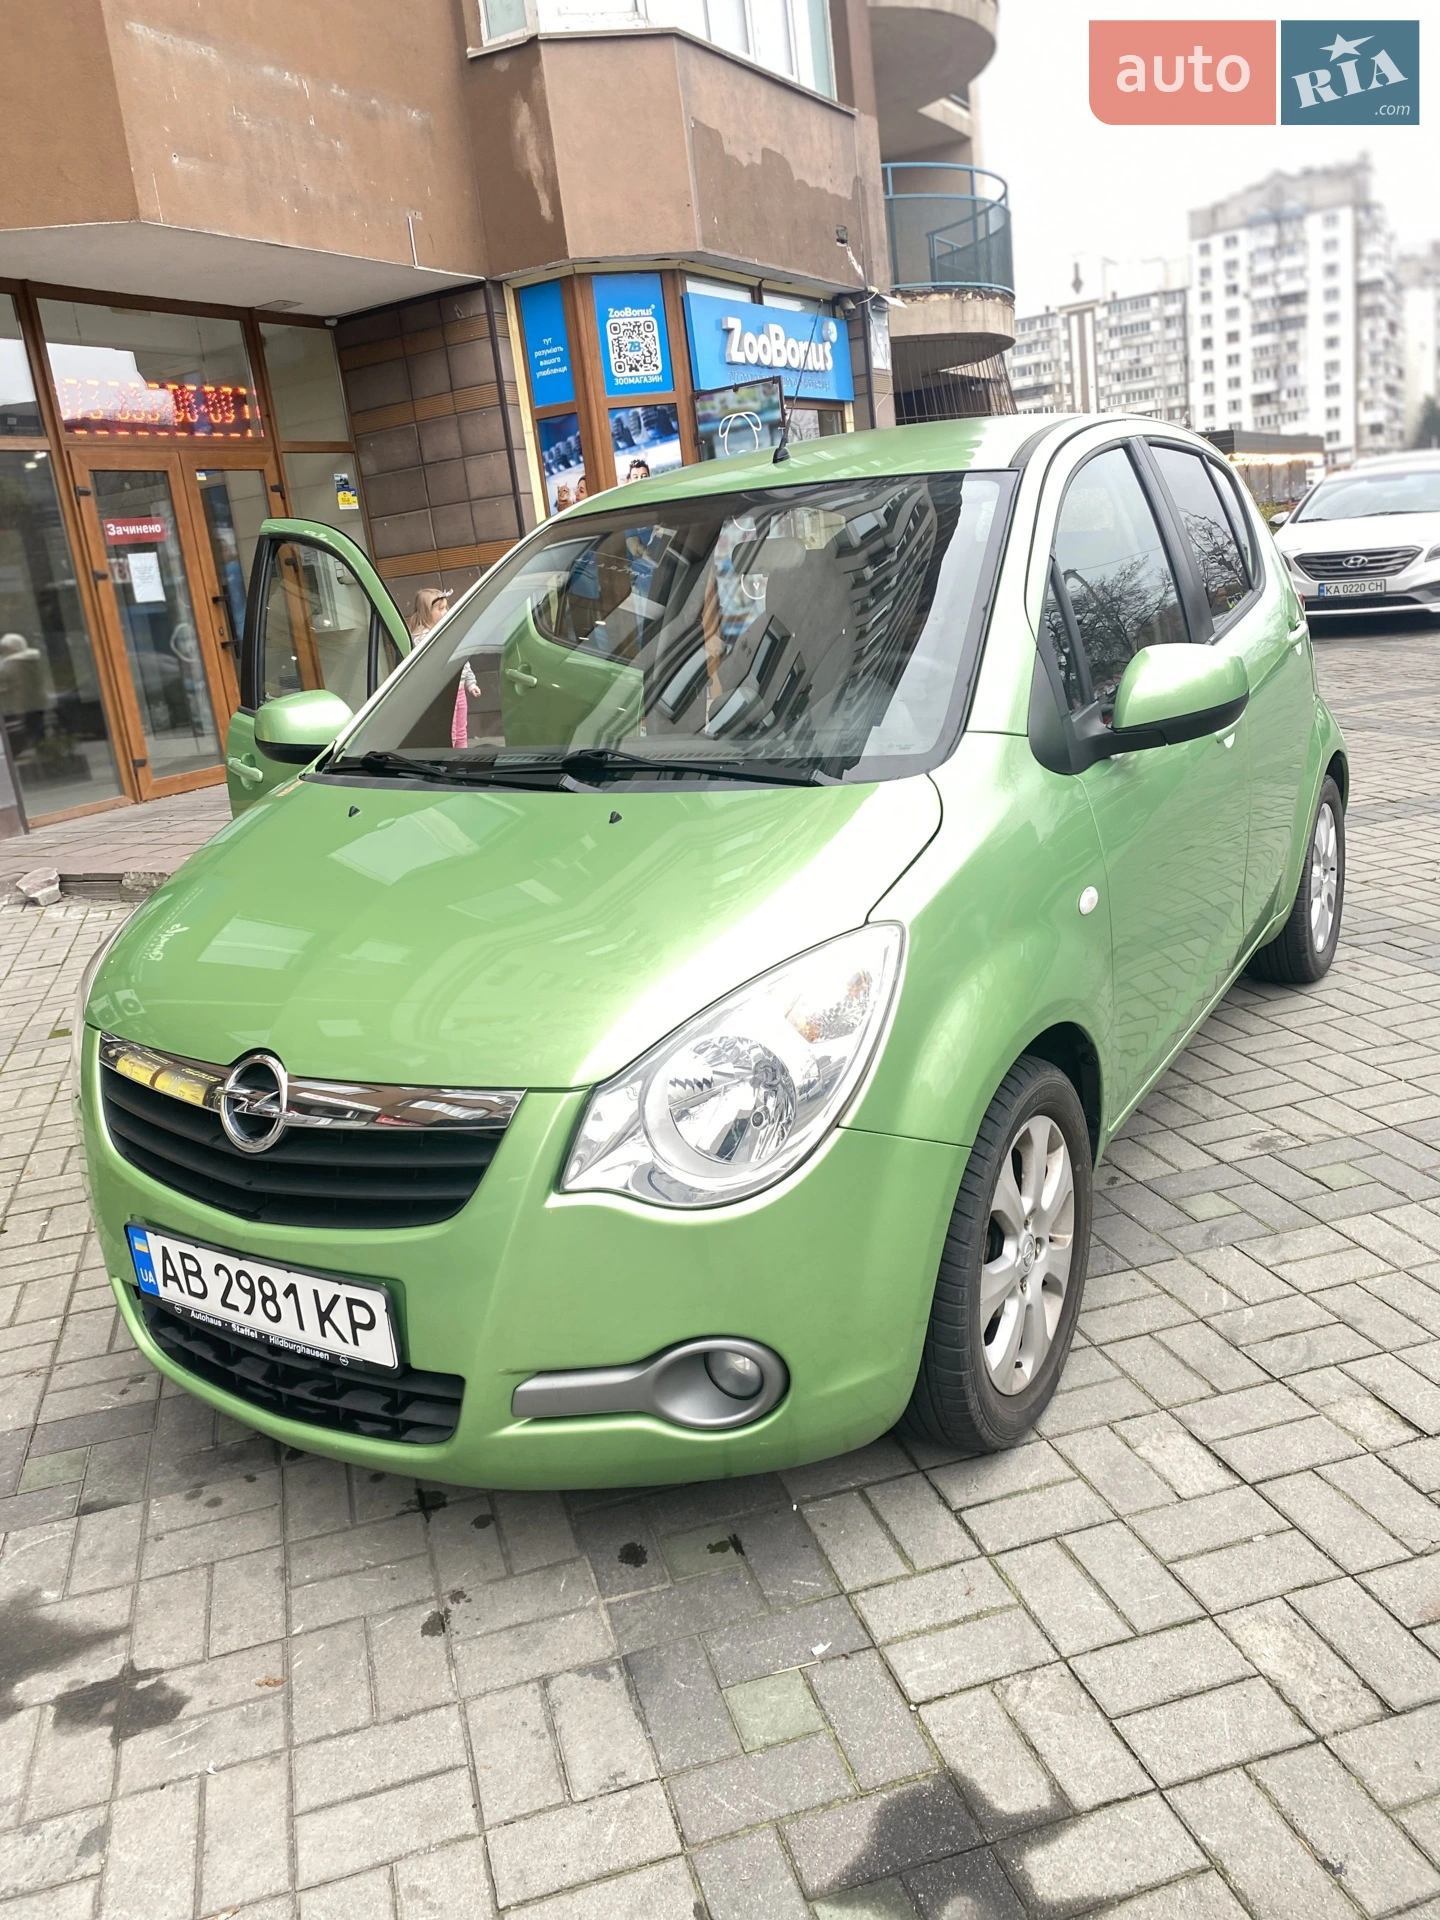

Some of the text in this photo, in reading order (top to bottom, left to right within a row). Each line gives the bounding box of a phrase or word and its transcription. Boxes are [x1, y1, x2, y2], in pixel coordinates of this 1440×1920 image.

[608, 307, 653, 318] ZooBonus
[722, 316, 834, 371] ZooBonus
[614, 375, 663, 386] ЗООМАГАЗИН
[106, 523, 162, 536] Зачинено
[1325, 581, 1383, 595] KA 0220 CH
[140, 1267, 156, 1286] UA
[161, 1245, 376, 1347] AB 2981 KP
[190, 1310, 330, 1360] Autohaus Staffel Hildburghausen
